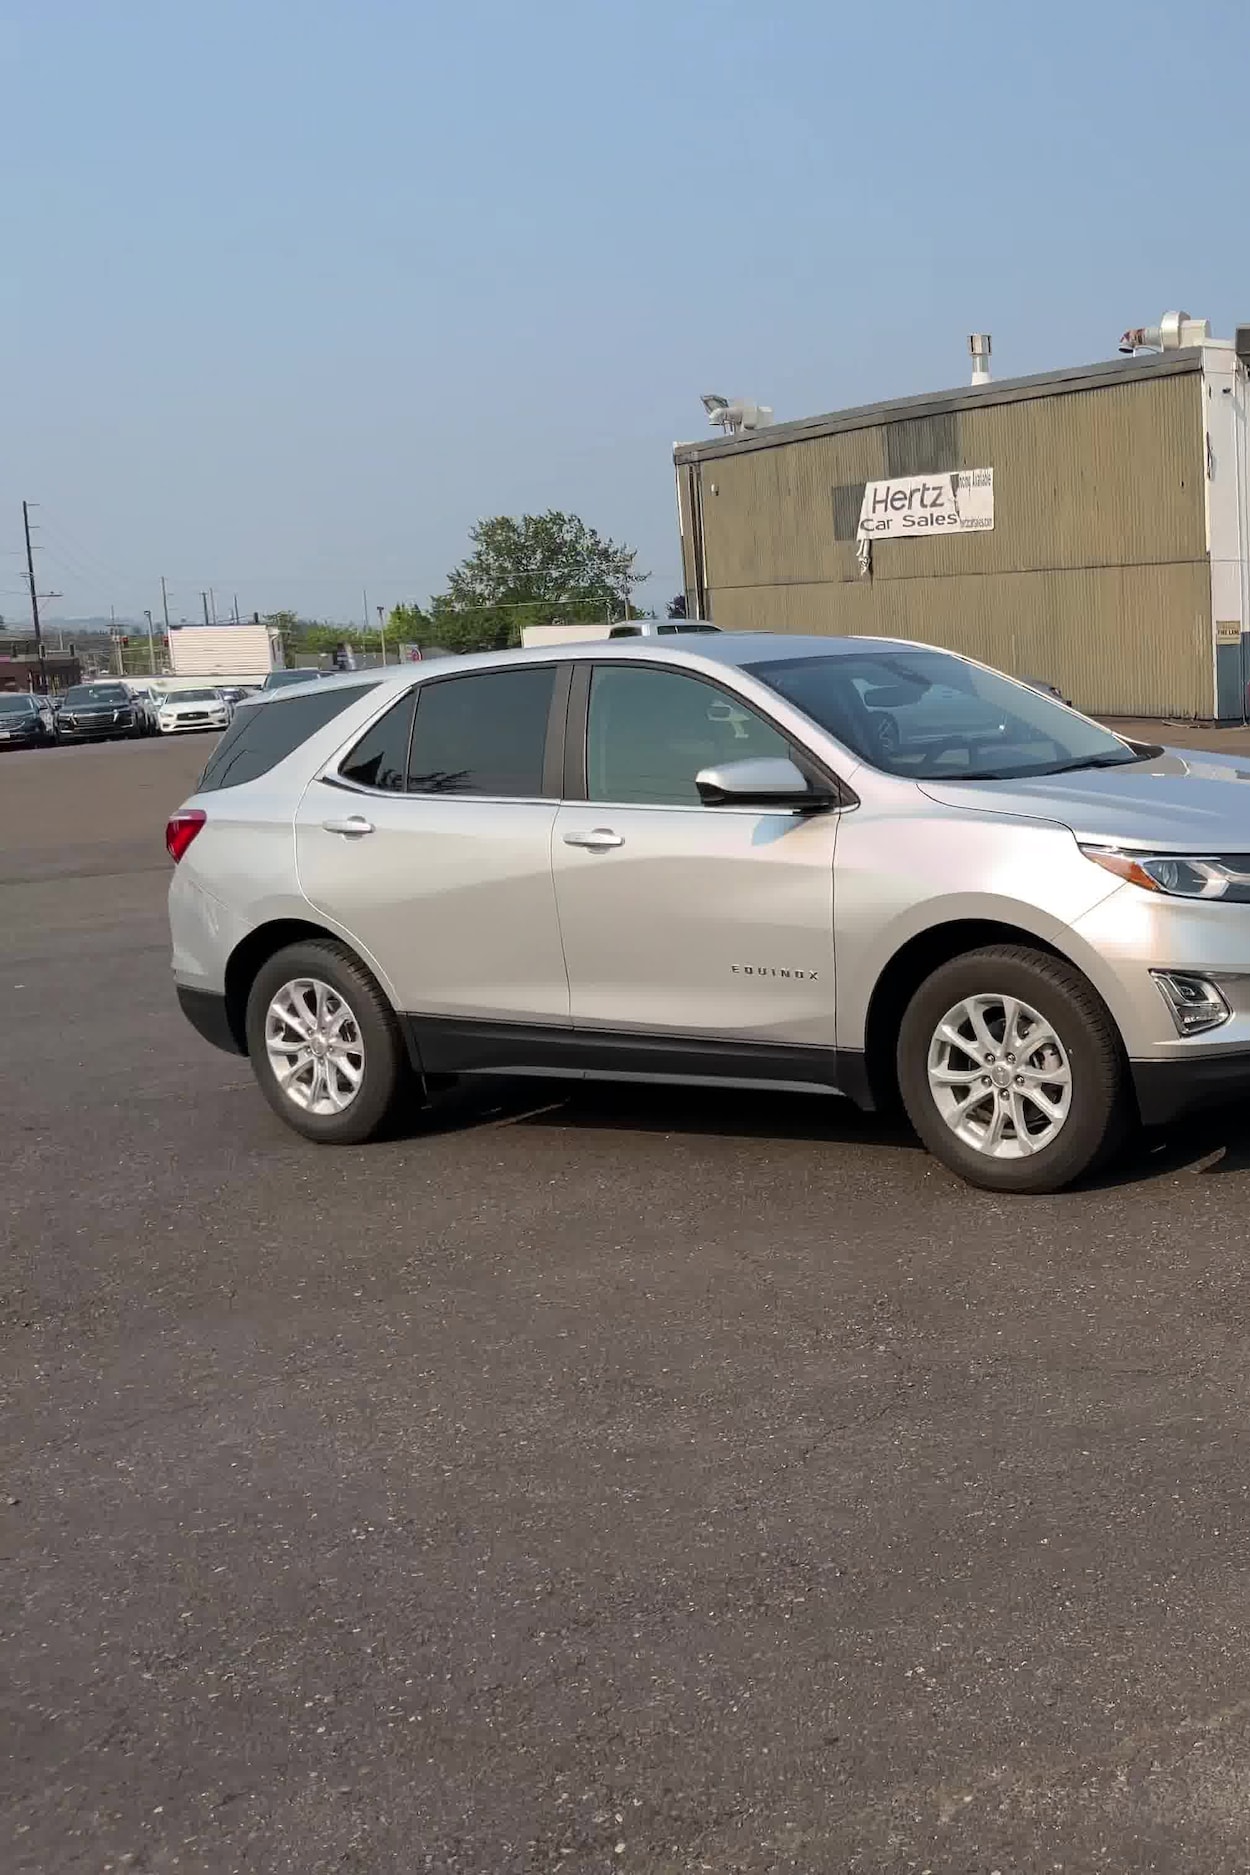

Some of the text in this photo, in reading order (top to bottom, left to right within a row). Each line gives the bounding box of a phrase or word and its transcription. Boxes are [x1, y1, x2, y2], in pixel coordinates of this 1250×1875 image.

[872, 483, 944, 514] Hertz
[860, 518, 893, 532] Car
[902, 513, 957, 528] Sales
[731, 965, 818, 980] EQUINOX
